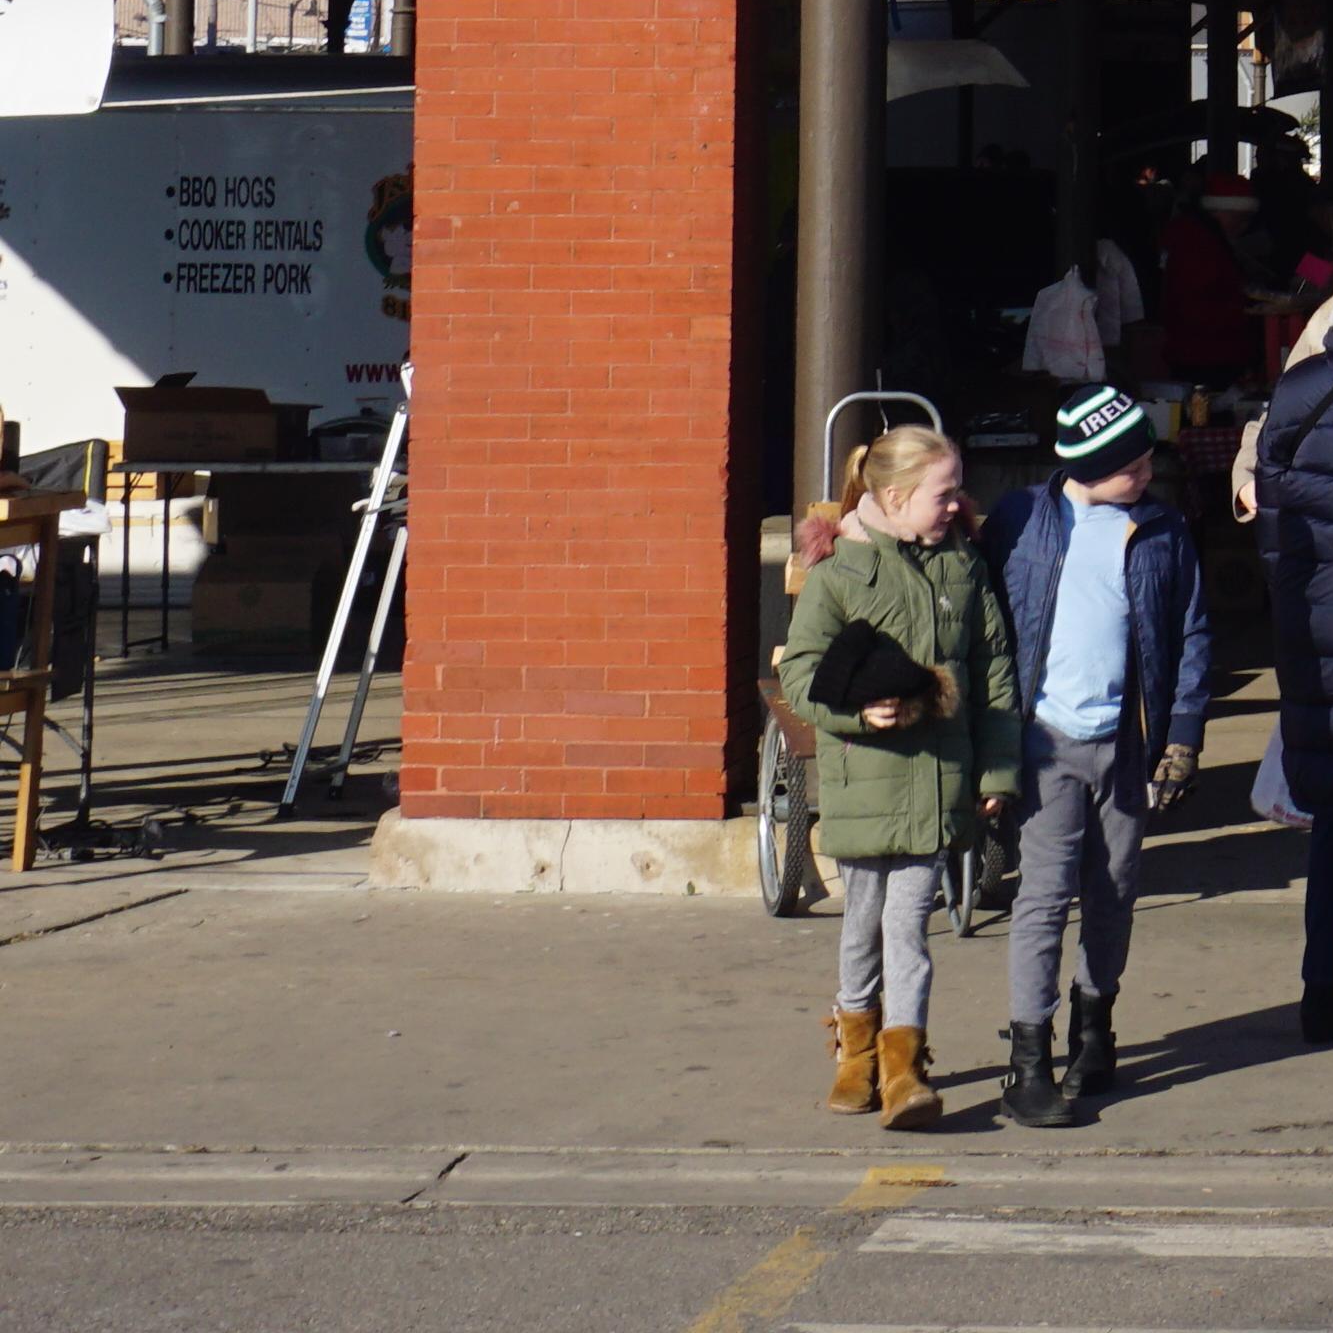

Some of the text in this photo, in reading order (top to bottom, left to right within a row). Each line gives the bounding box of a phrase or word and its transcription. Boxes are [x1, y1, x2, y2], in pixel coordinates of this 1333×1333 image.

[180, 176, 276, 208] BBQ HOGS
[178, 219, 324, 252] COOKER RENTALS
[176, 263, 312, 294] FREEZER PORK
